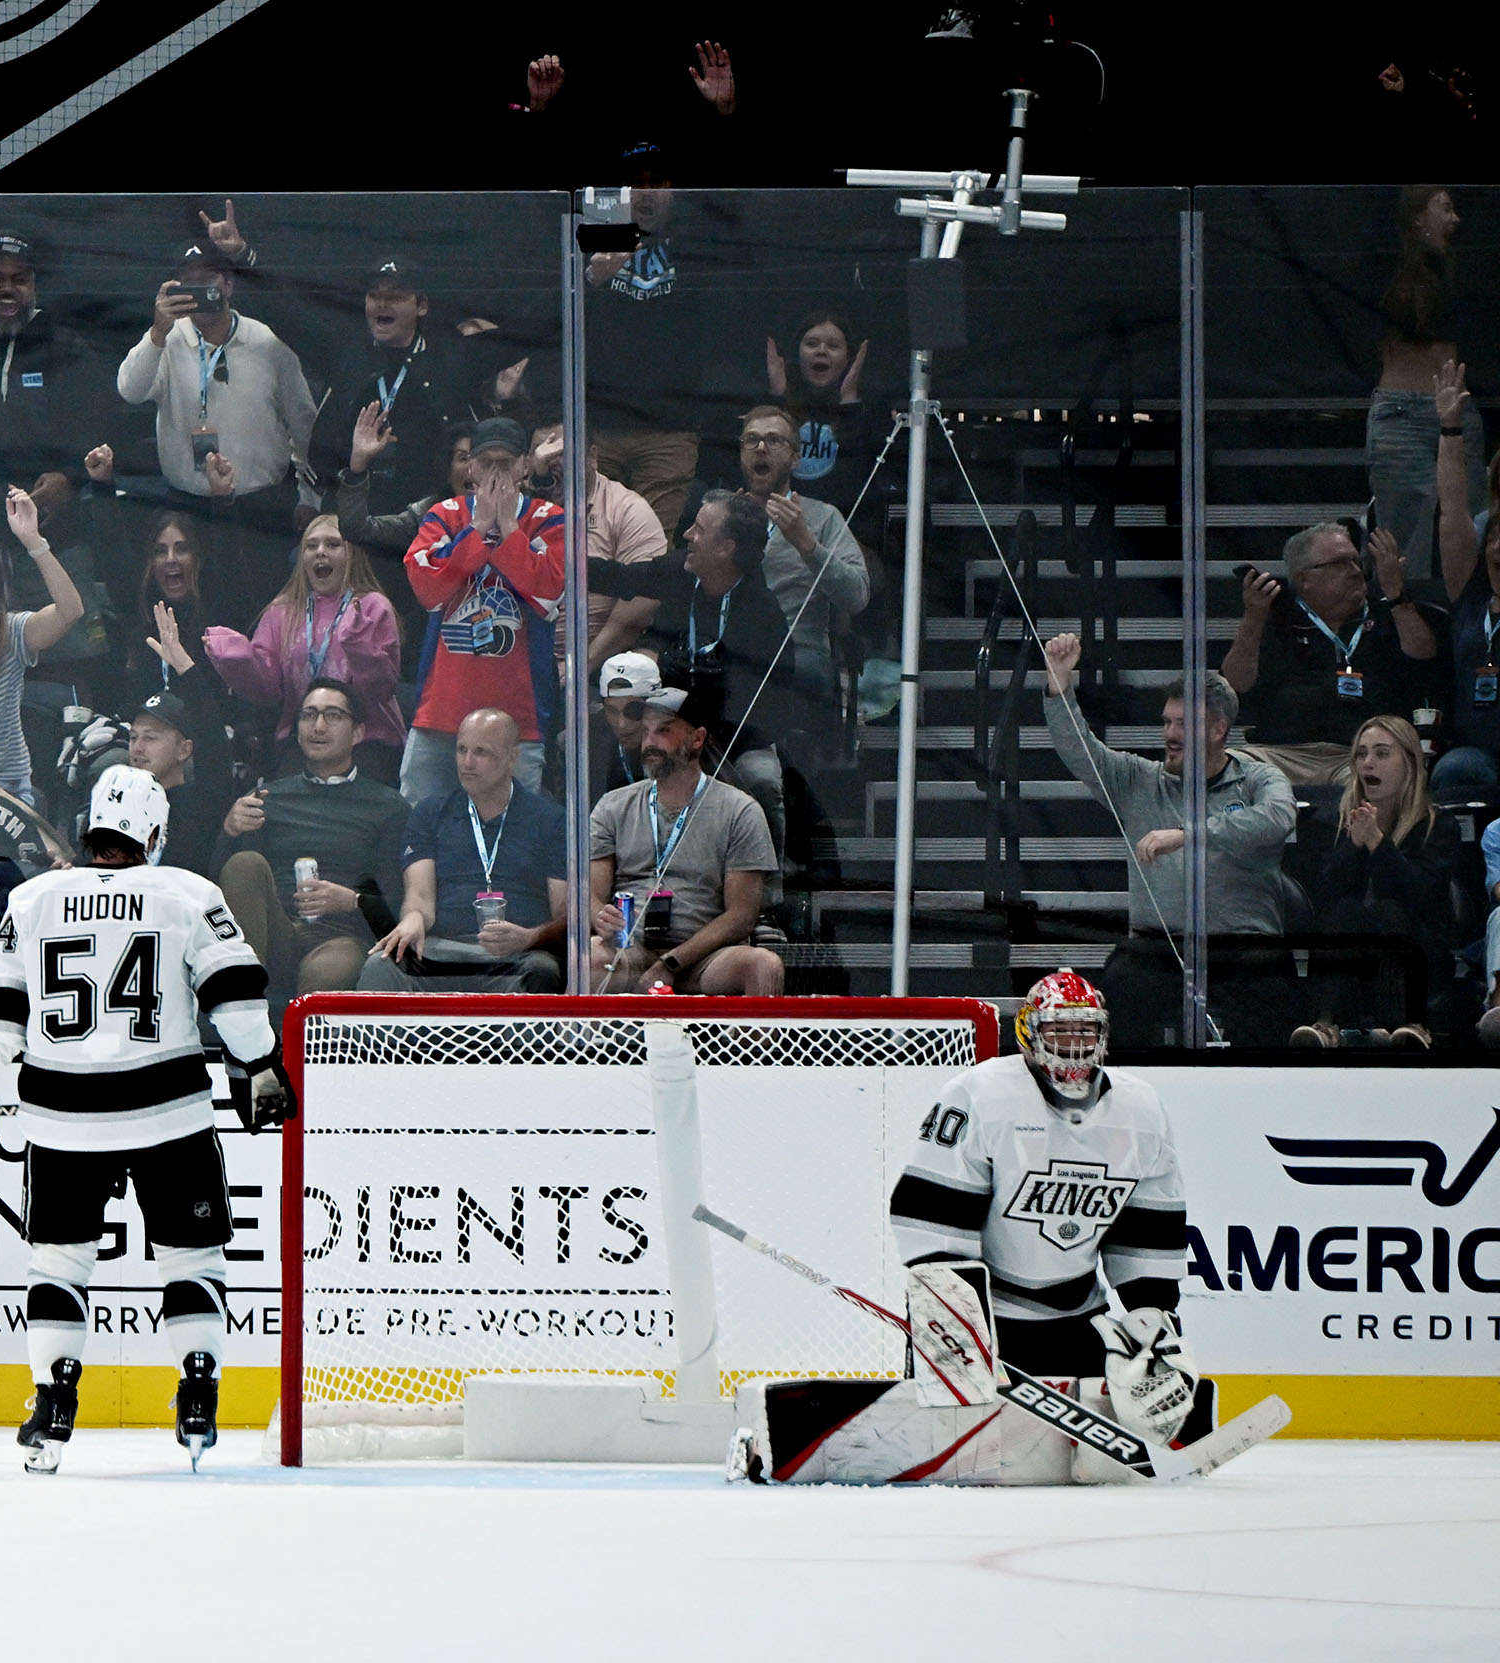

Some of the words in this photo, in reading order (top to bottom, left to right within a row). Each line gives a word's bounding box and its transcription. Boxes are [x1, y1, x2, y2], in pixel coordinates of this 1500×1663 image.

[801, 440, 832, 459] TAH
[64, 894, 144, 923] HUDON
[40, 931, 162, 1043] 54
[918, 1102, 969, 1148] 40
[1057, 1168, 1070, 1178] Los
[1072, 1170, 1099, 1180] Angeles
[1020, 1181, 1126, 1218] KINGS
[928, 1319, 975, 1367] CCM
